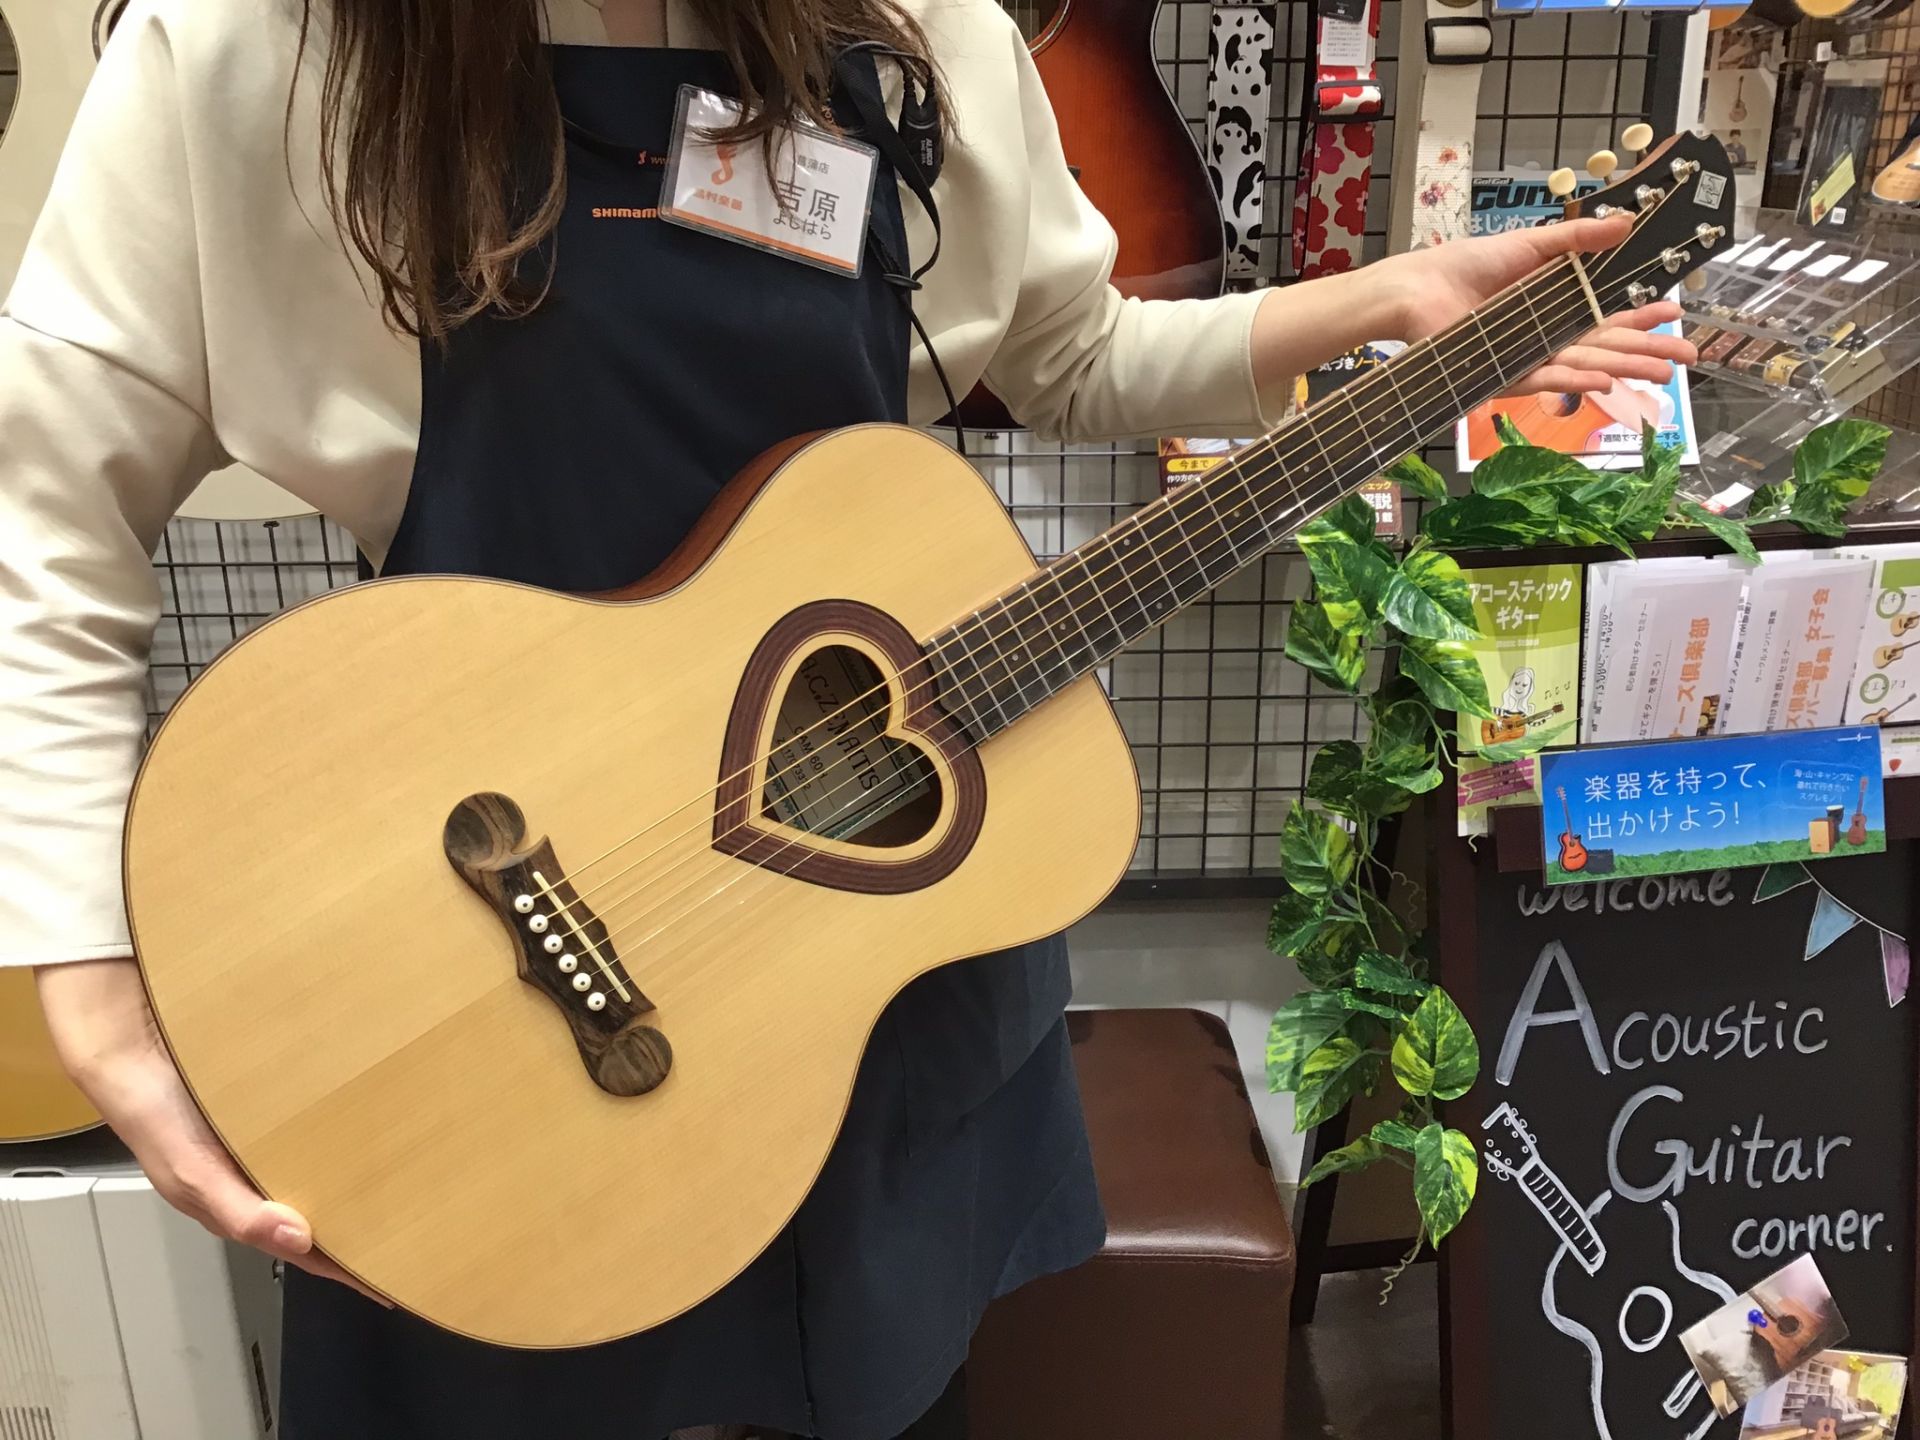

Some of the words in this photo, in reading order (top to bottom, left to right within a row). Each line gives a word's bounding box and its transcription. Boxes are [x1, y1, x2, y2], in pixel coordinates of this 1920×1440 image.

[777, 180, 839, 222] 吉原
[1471, 185, 1597, 211] GUITR
[1469, 578, 1573, 604] アコースティック
[1496, 605, 1539, 630] ギター
[1804, 588, 1830, 642] 女子会
[1584, 762, 1767, 803] 楽器を持って、
[1495, 939, 1828, 1086] Acoustic
[1607, 1085, 1852, 1203] Guitar
[1732, 1209, 1893, 1259] corner.
